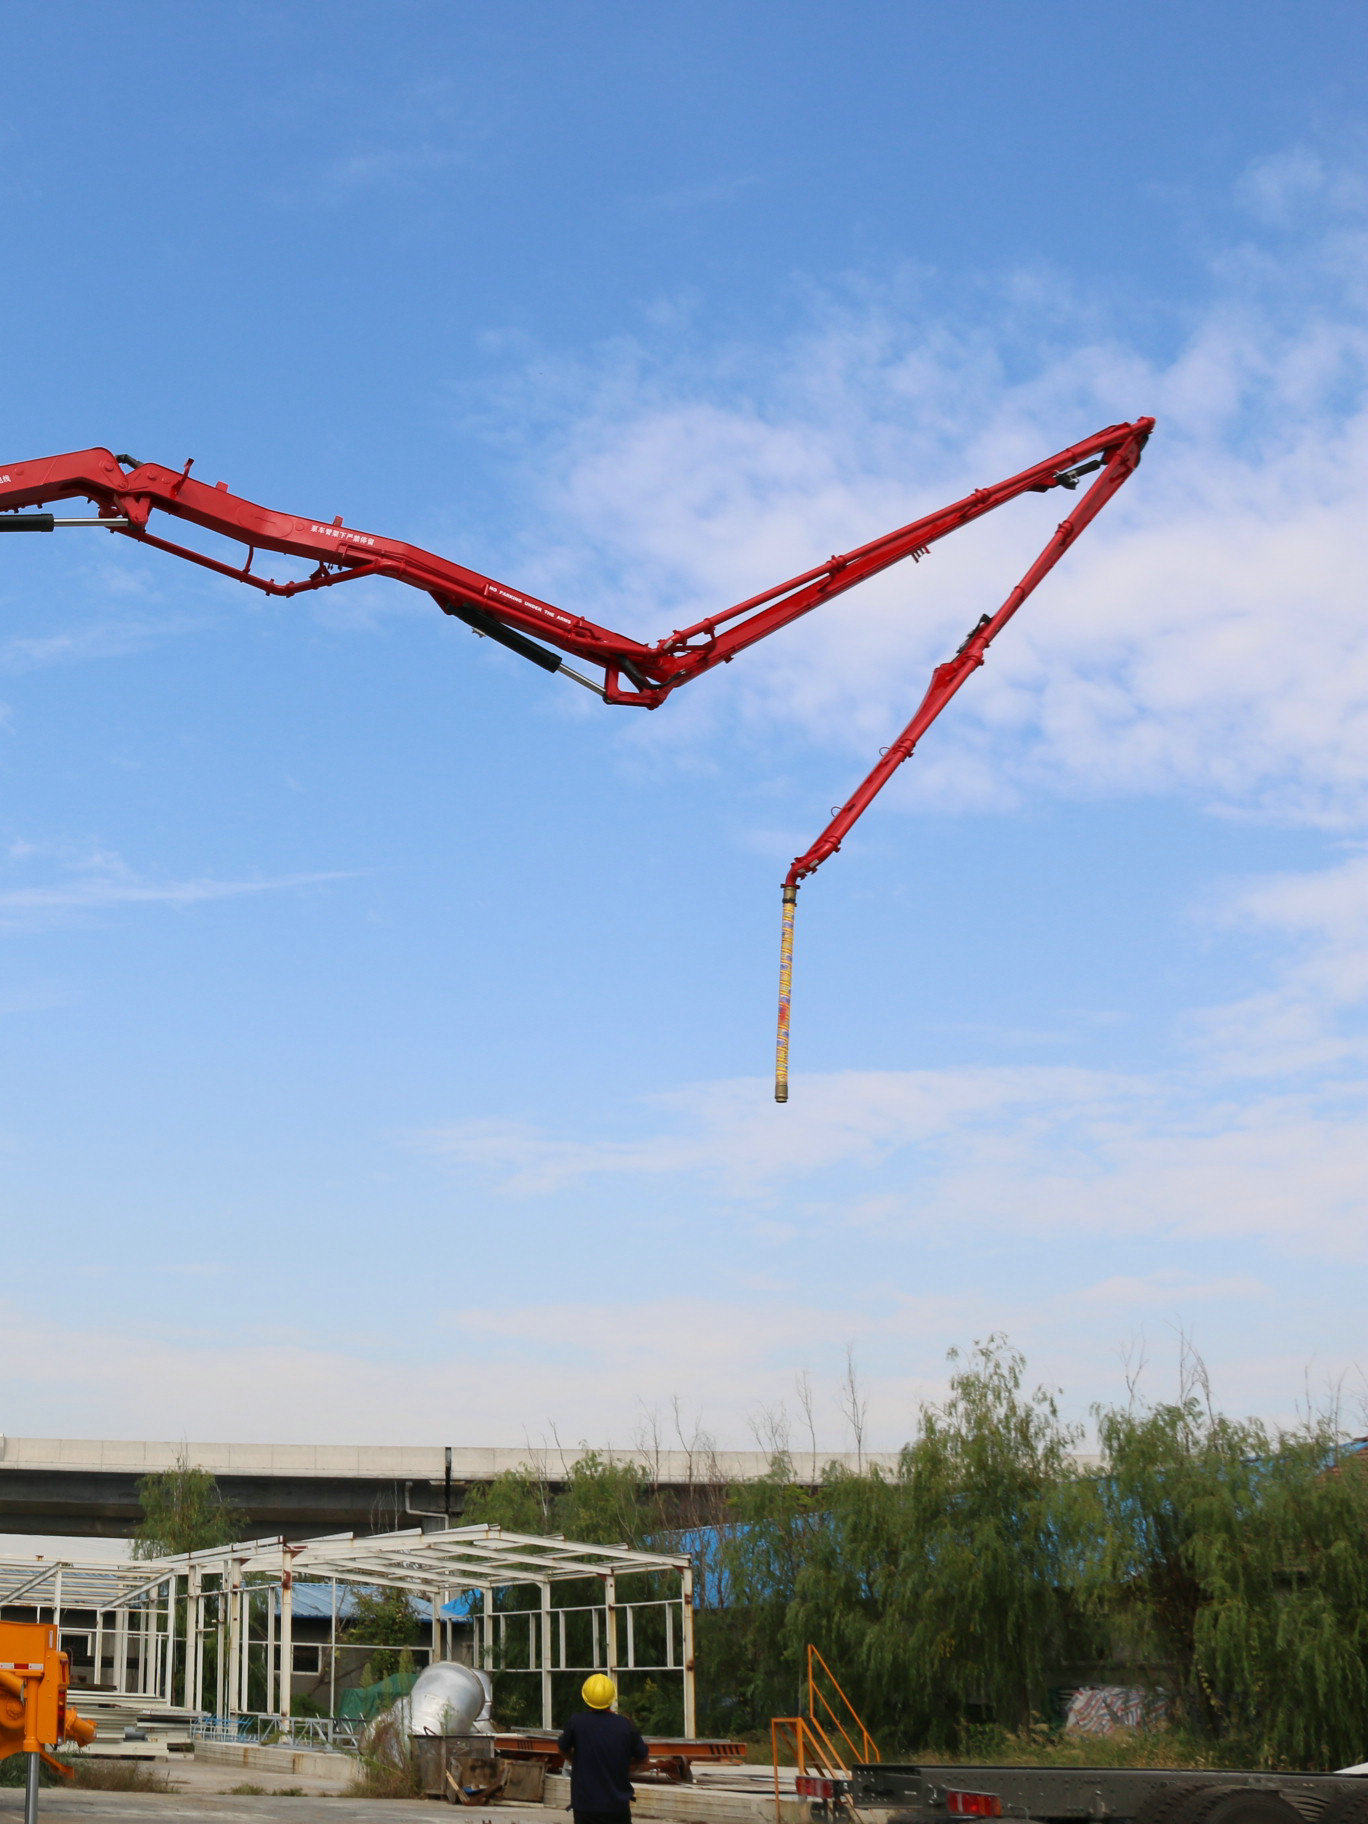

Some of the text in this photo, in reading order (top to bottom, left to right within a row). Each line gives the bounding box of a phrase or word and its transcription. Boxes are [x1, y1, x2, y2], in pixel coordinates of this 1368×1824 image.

[499, 590, 522, 603] PARKING
[524, 601, 542, 612] UNDER
[556, 615, 571, 624] ARMS
